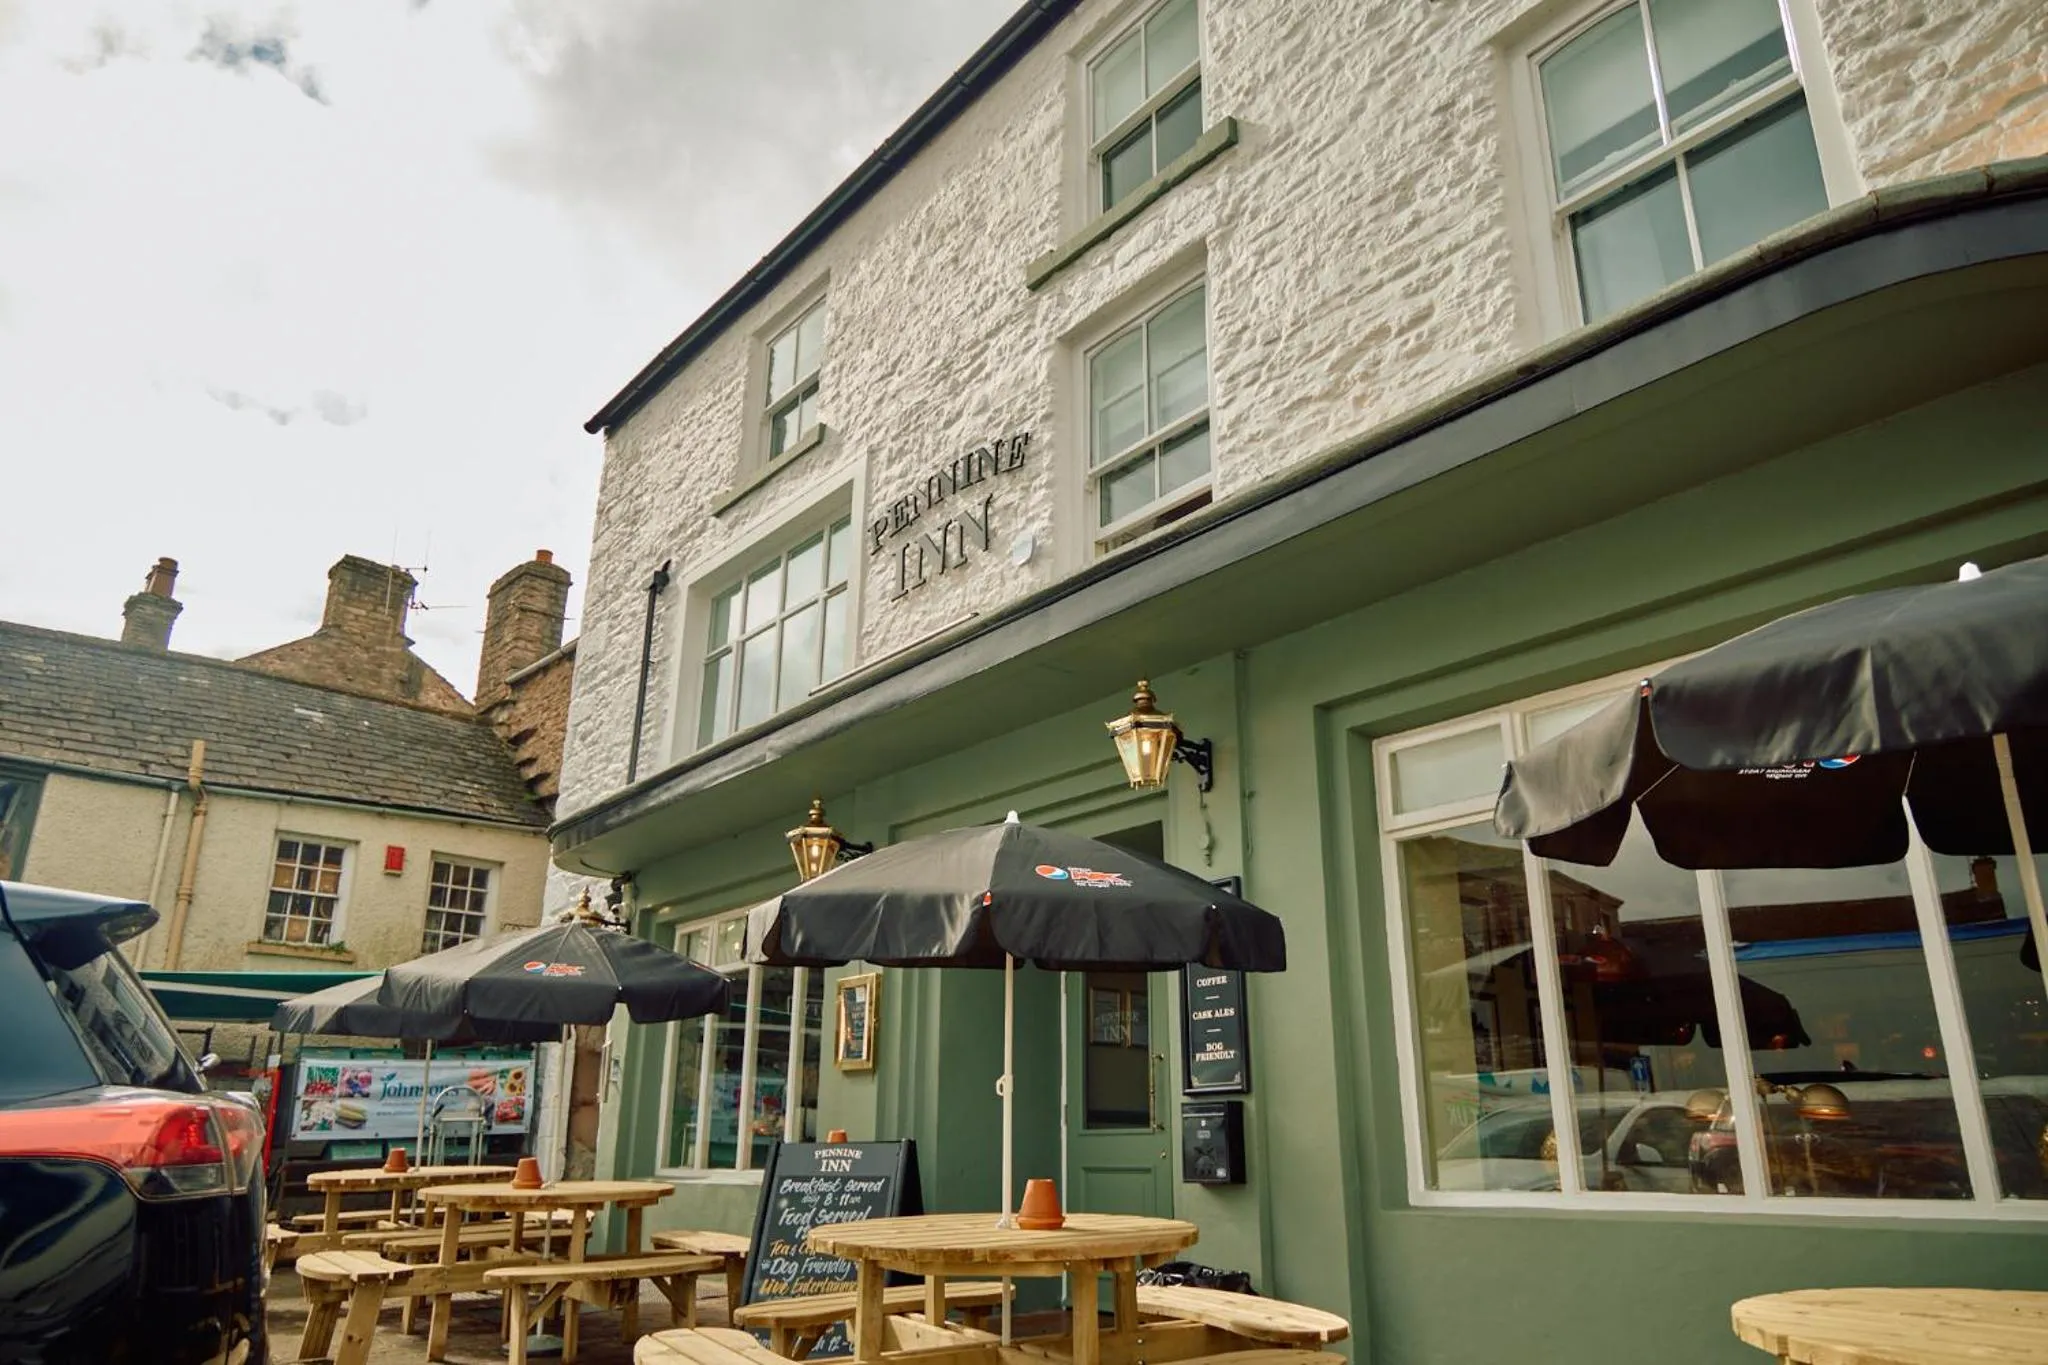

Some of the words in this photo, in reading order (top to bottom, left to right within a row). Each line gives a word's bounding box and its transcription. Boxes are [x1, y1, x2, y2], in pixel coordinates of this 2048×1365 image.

[868, 432, 1030, 556] PENNINE
[891, 493, 993, 602] INN
[1196, 975, 1228, 988] COFFEE
[1192, 1009, 1213, 1021] CASK
[1214, 1007, 1235, 1018] ALES
[1206, 1042, 1224, 1052] DOG
[1195, 1050, 1236, 1062] FRIENDLY
[814, 1147, 863, 1160] PENNINE
[820, 1159, 853, 1172] INN
[780, 1177, 841, 1194] Breakfast
[844, 1179, 885, 1193] Served
[778, 1206, 817, 1226] Food
[815, 1205, 872, 1224] Served
[769, 1258, 800, 1283] Dog
[801, 1256, 851, 1281] Friendly
